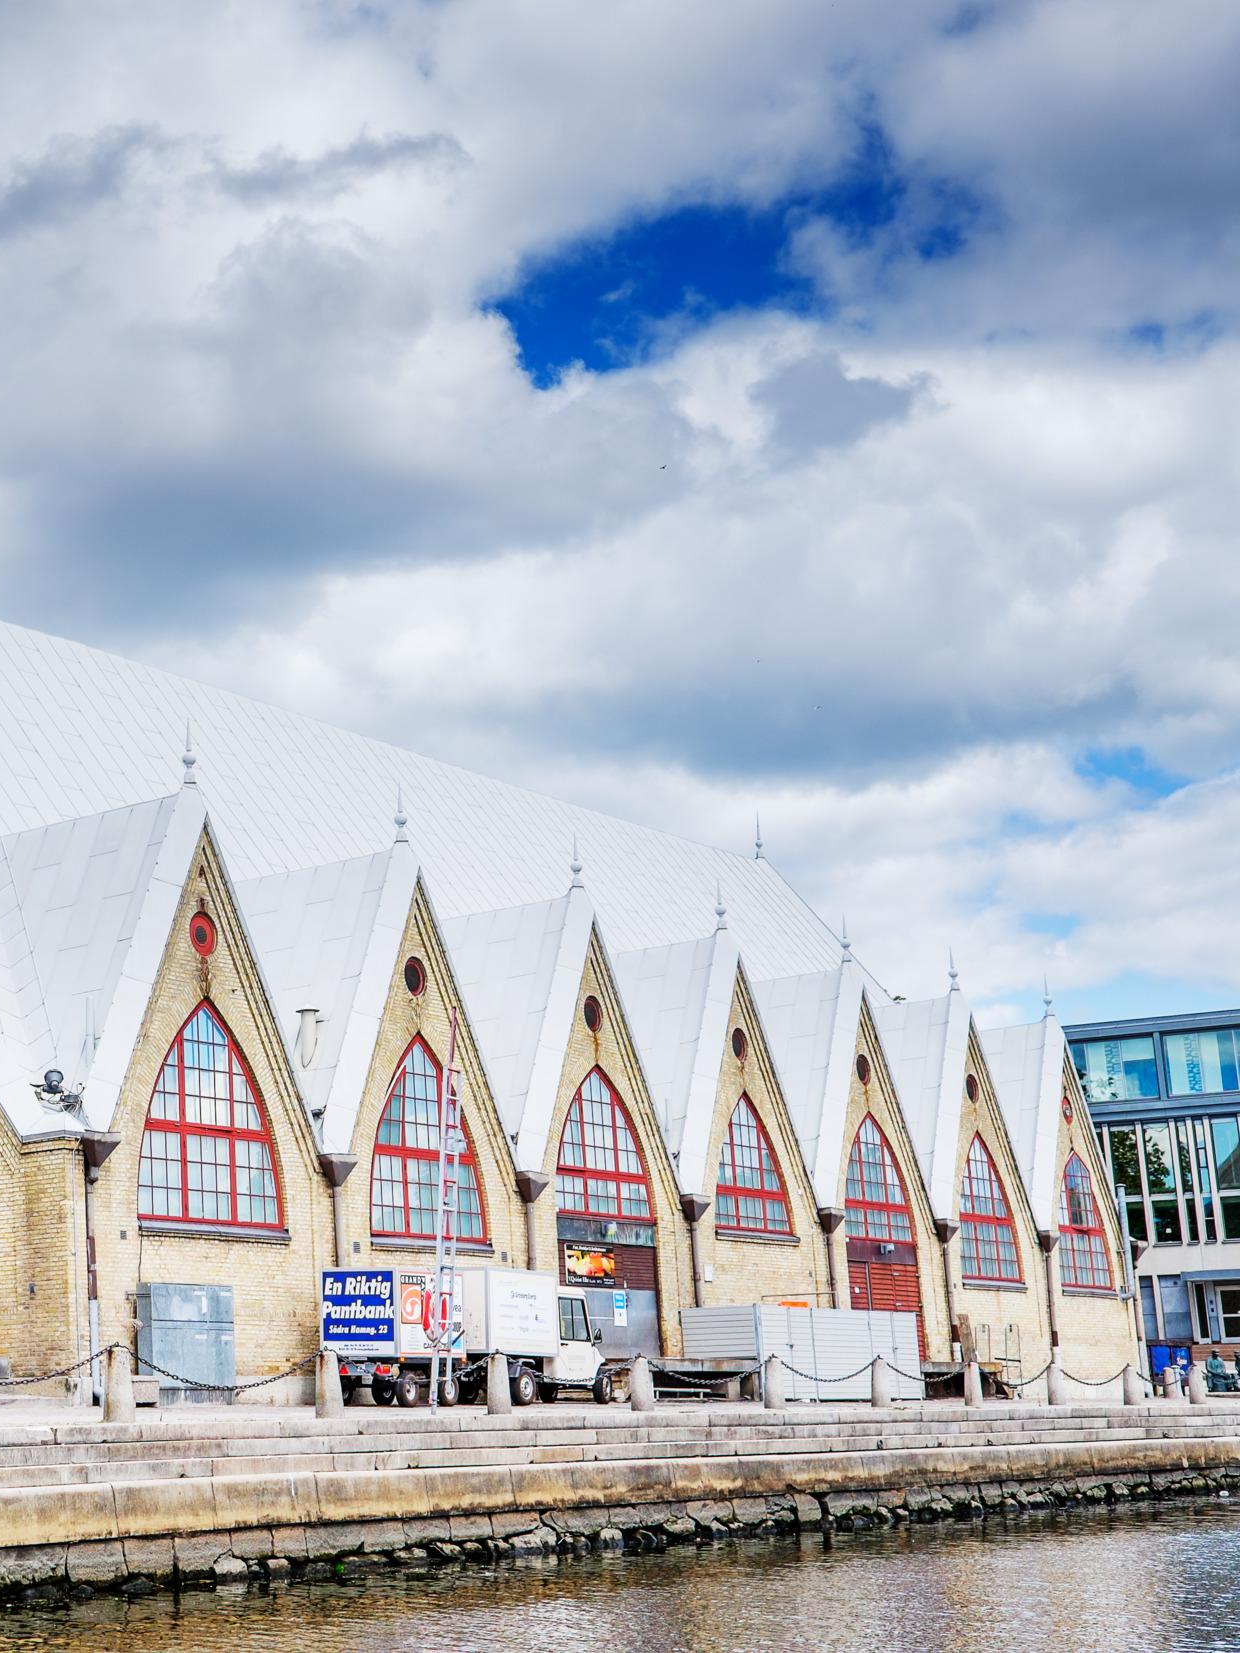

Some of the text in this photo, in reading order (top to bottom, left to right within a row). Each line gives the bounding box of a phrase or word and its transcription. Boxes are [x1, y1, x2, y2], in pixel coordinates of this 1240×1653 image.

[324, 1275, 391, 1299] En Riktig
[323, 1299, 394, 1319] Pantbank
[329, 1325, 349, 1333] Södra
[378, 1325, 388, 1334] 23
